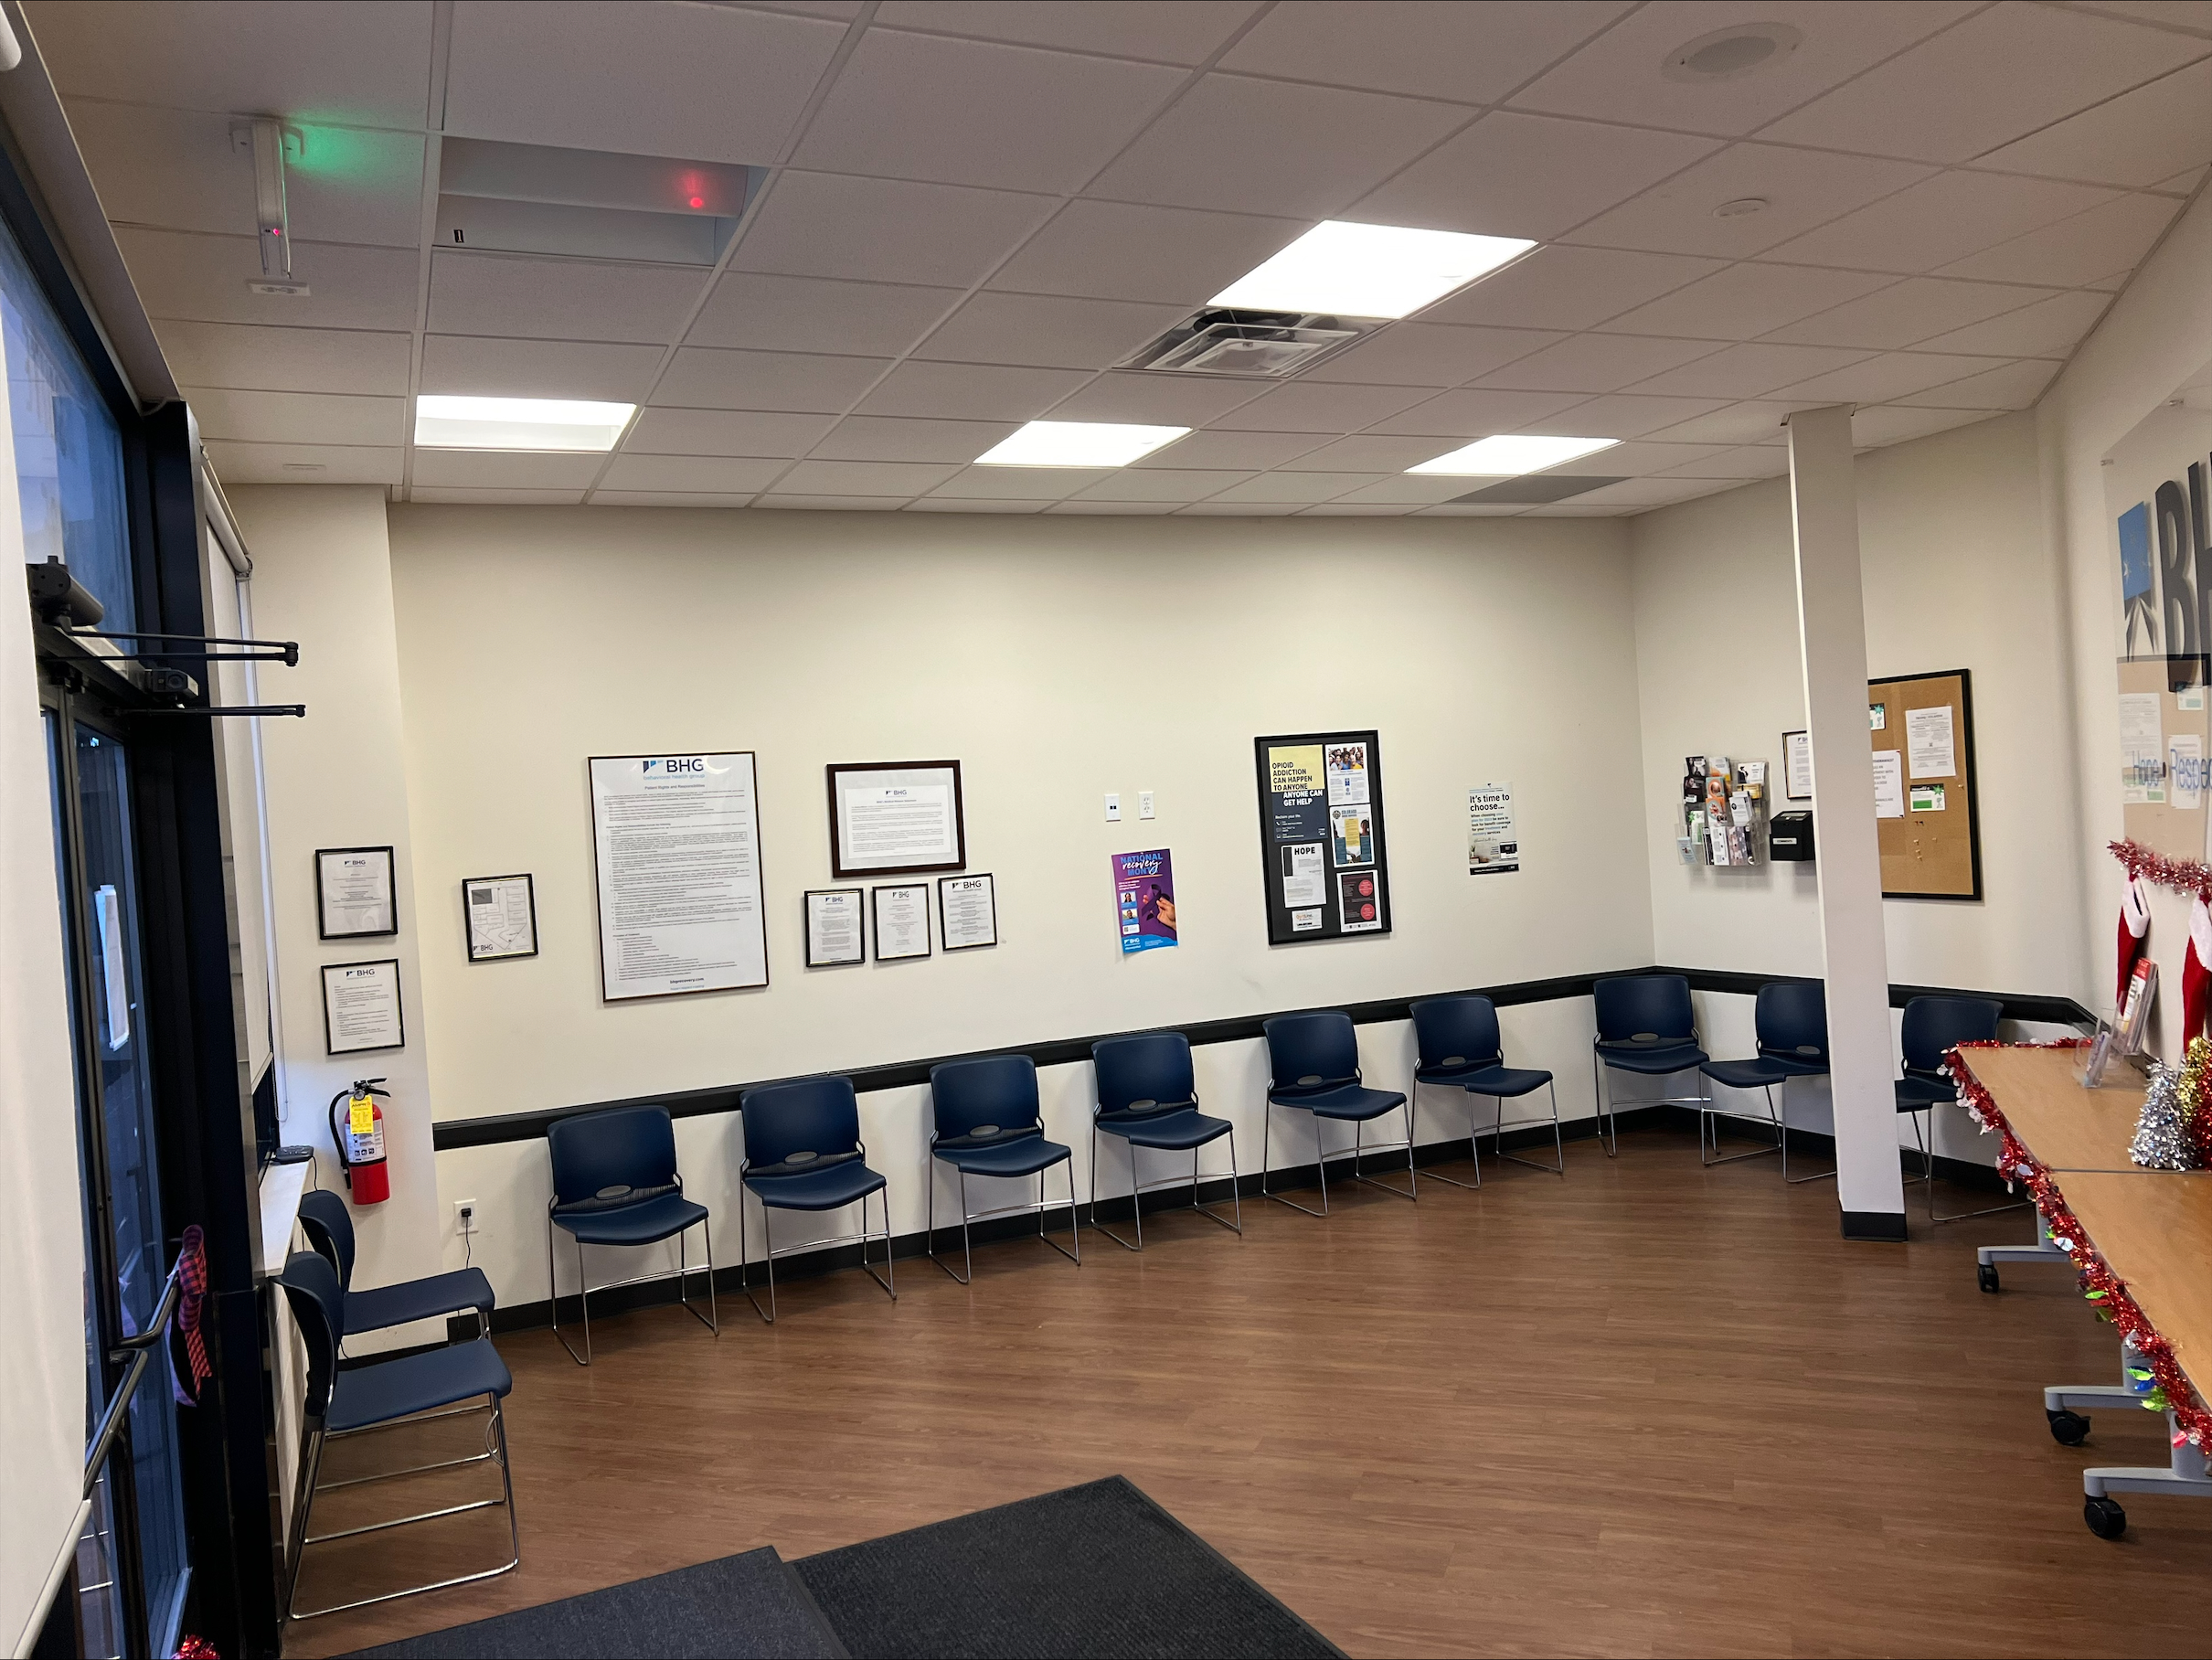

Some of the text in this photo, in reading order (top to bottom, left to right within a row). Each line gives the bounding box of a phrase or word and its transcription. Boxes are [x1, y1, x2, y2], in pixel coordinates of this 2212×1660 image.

[666, 759, 704, 772] BHG
[1470, 794, 1482, 803] It's
[1483, 794, 1500, 803] time
[1294, 846, 1315, 855] HOPE
[1120, 853, 1163, 864] NATIONAL
[1122, 860, 1162, 875] recovery
[963, 880, 982, 889] BHG
